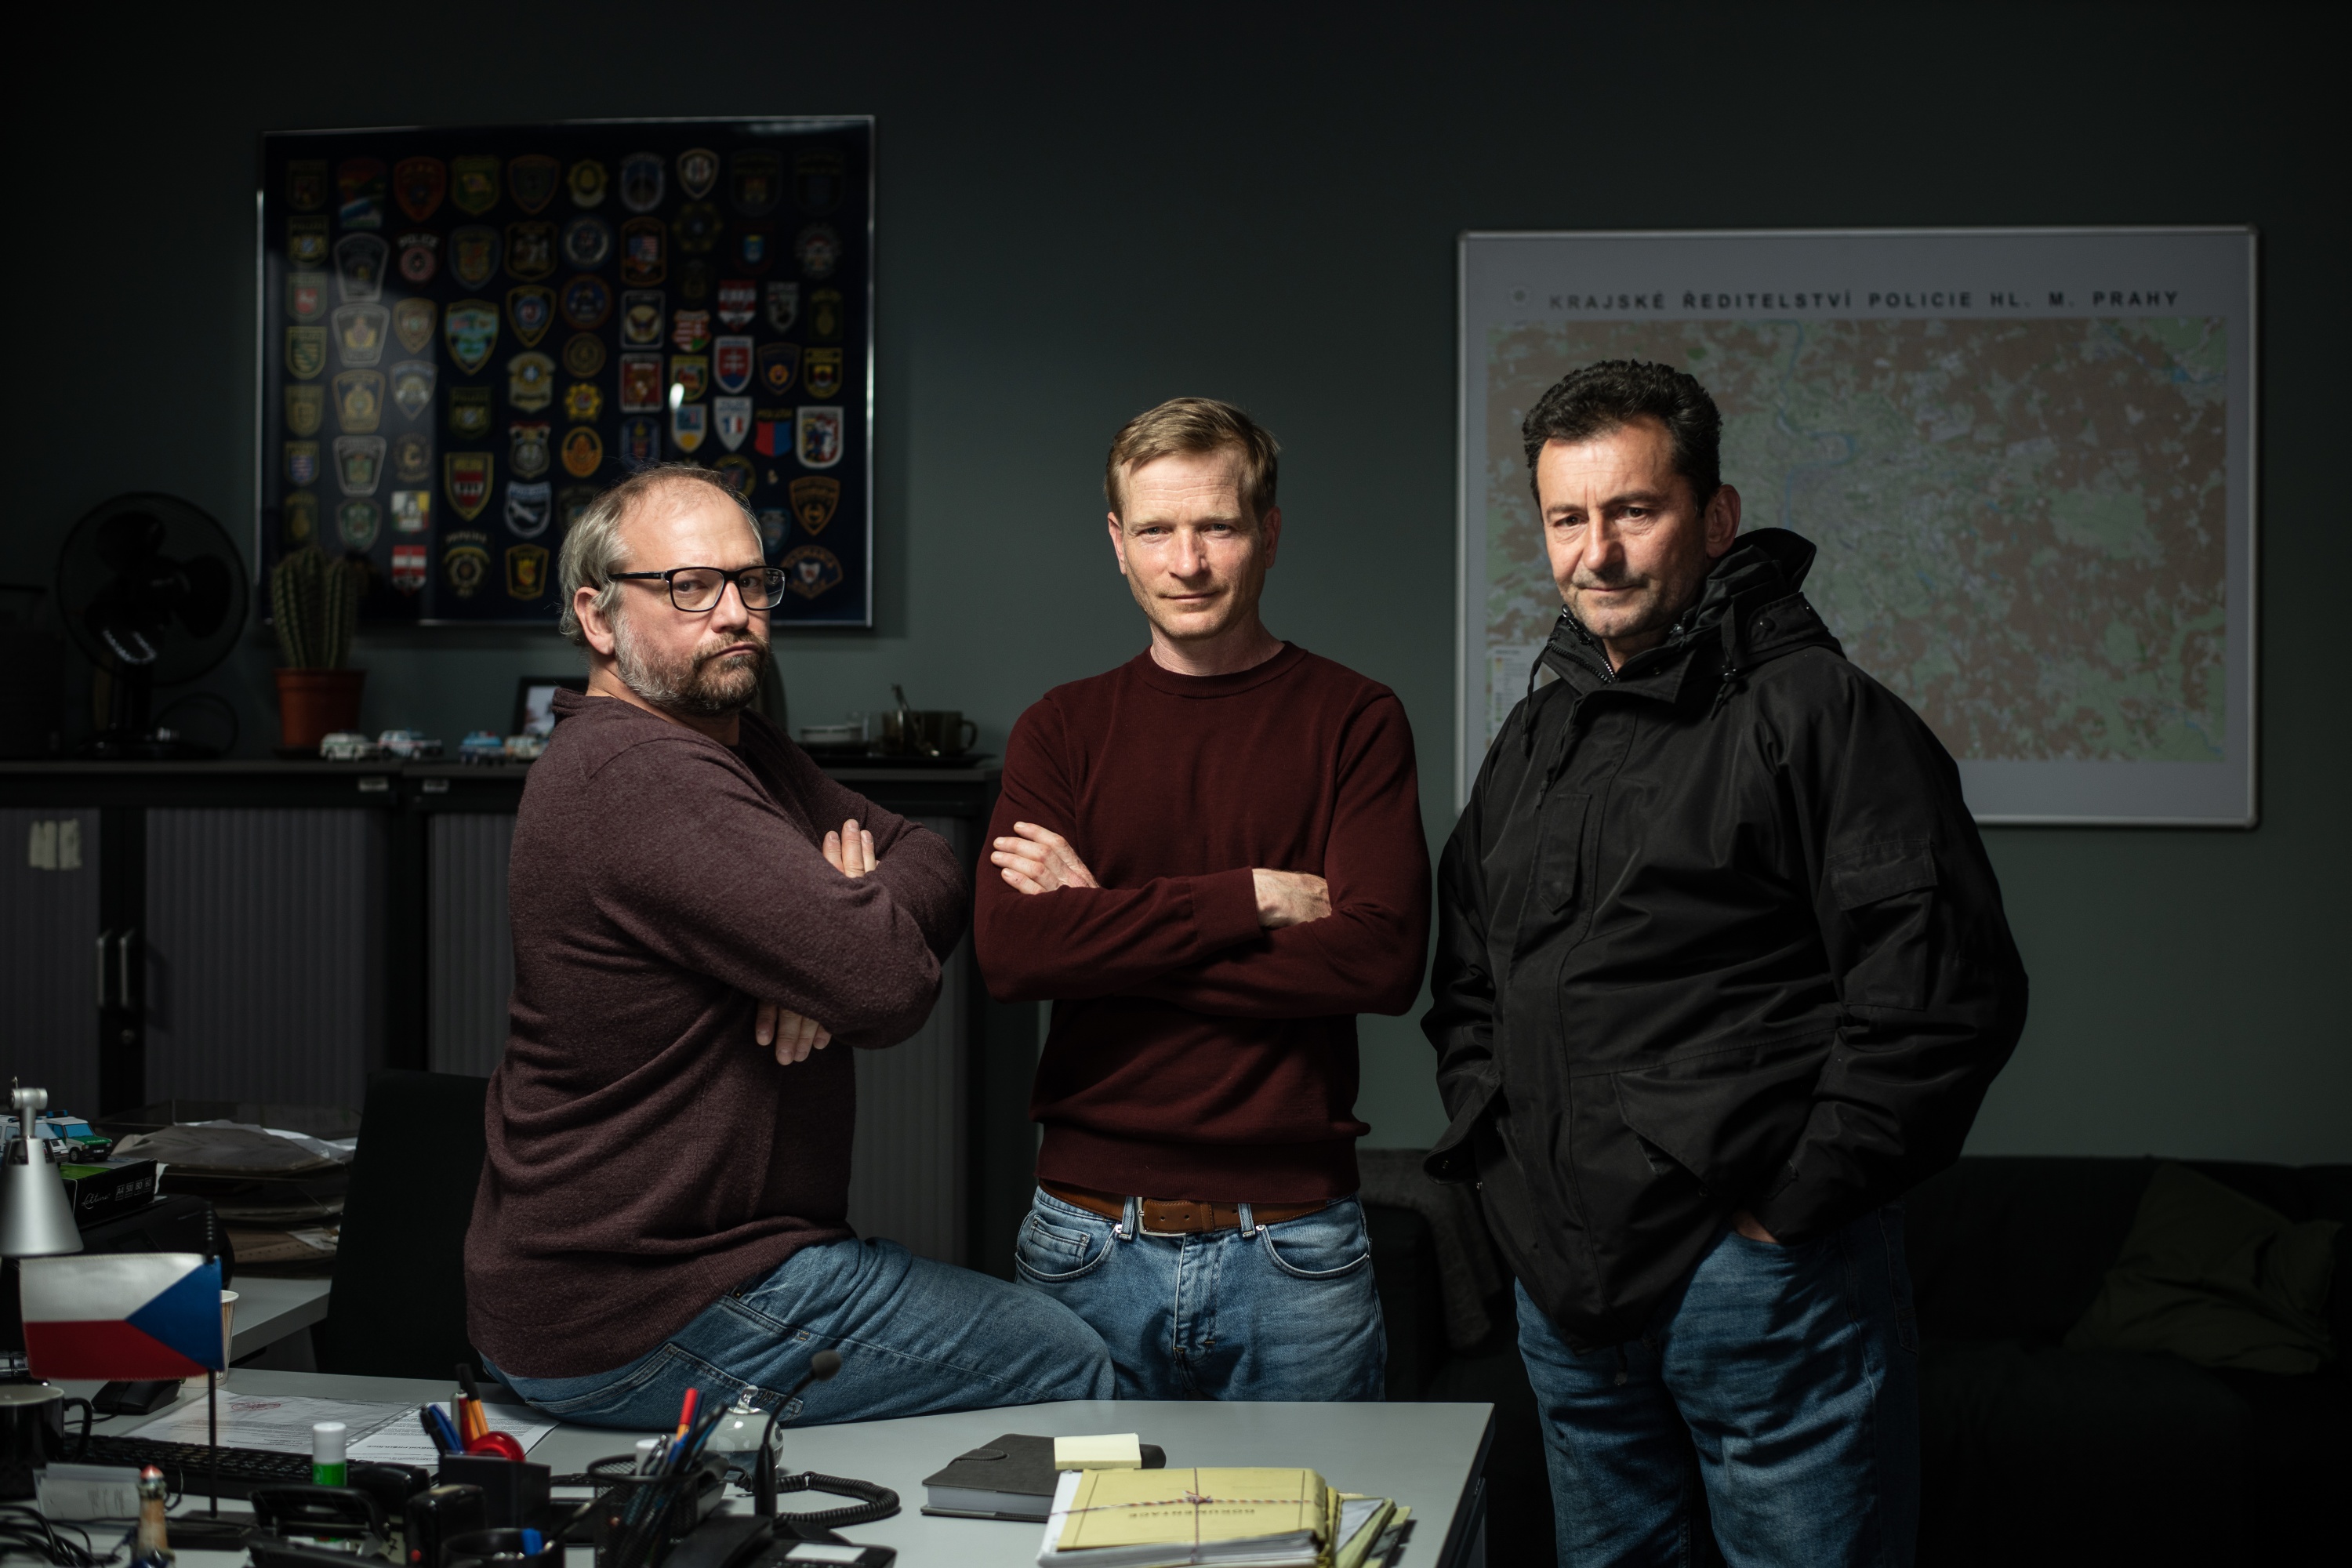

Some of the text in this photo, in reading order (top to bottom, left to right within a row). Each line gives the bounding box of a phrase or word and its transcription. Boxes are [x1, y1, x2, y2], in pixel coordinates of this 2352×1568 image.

[1549, 290, 2179, 310] KRAJSKÉ ŘEDITELSTVÍ POLICIE HL. M. PRAHY
